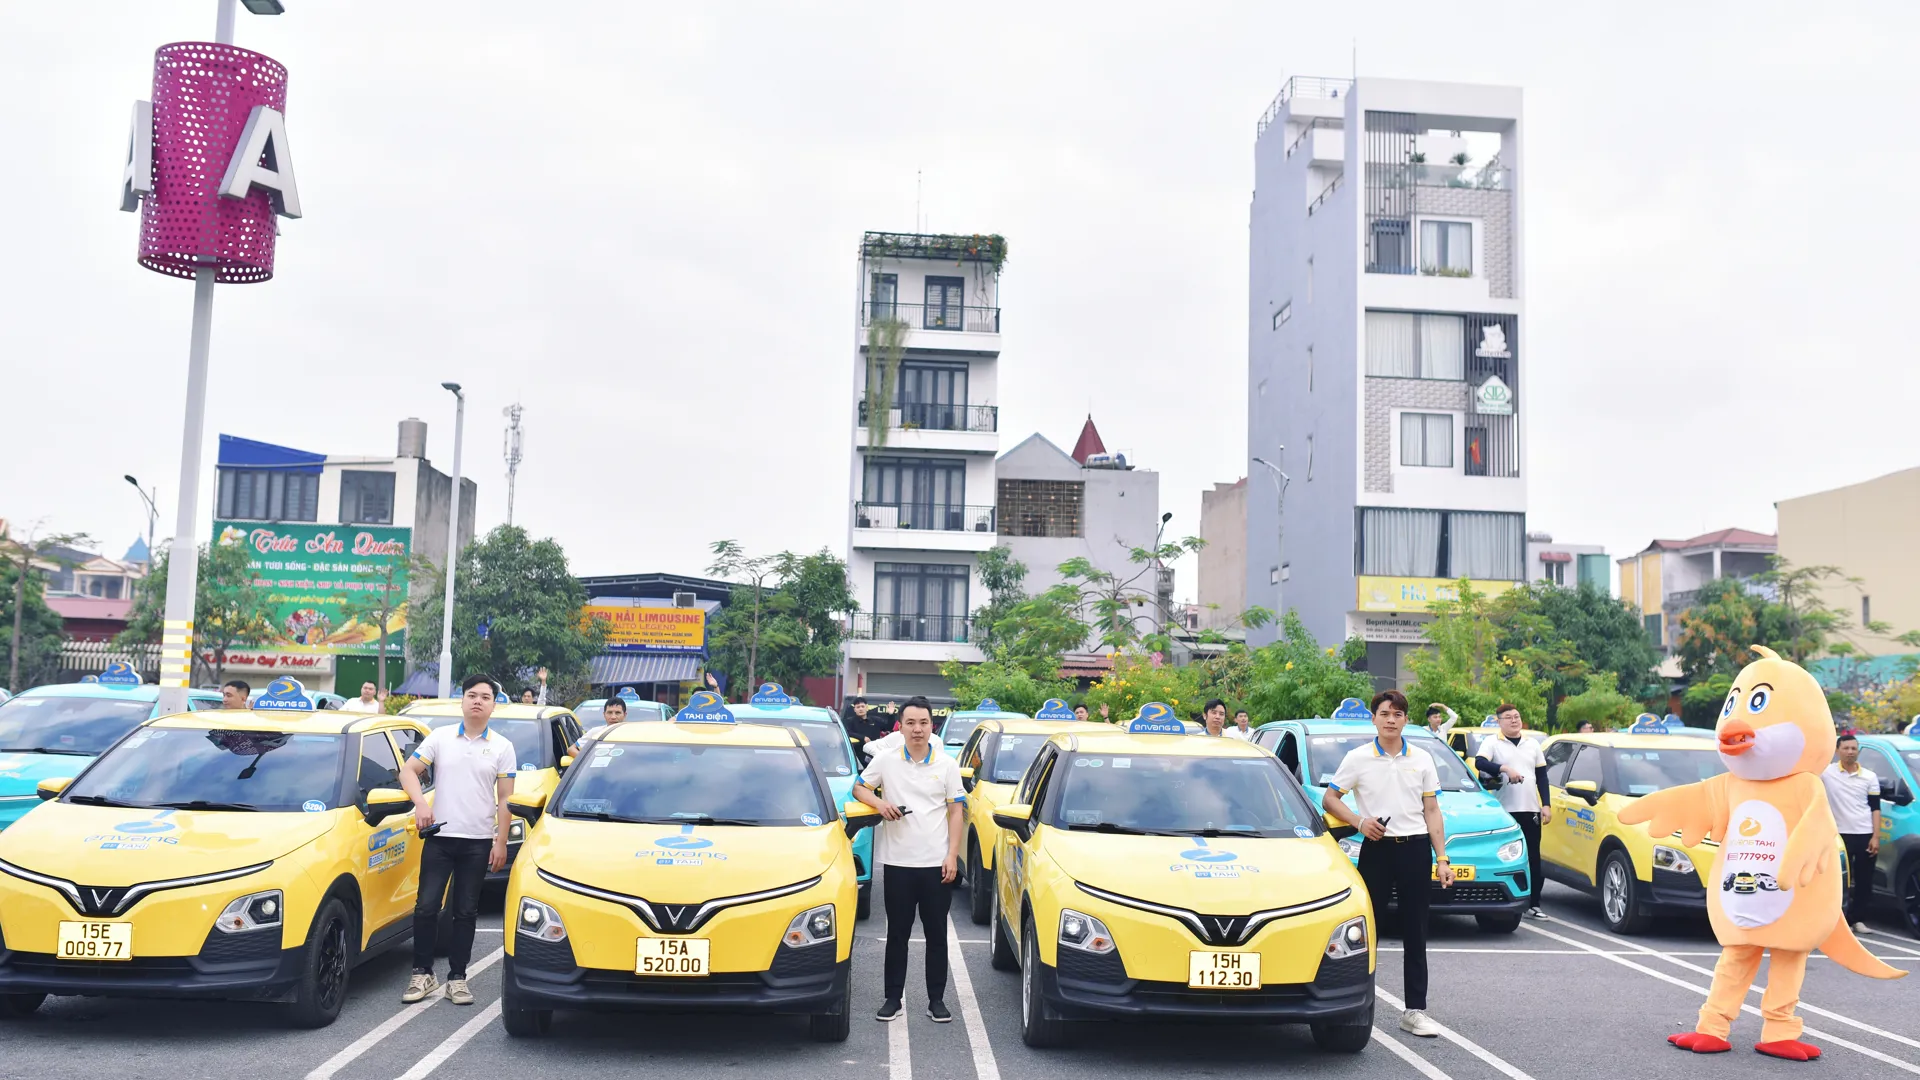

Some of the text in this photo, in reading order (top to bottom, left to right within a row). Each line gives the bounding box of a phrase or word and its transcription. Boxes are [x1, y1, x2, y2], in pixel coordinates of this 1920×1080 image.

[217, 105, 302, 219] A
[250, 528, 298, 554] Trúc
[305, 531, 344, 554] An
[616, 609, 635, 622] HẢI
[639, 613, 700, 624] LIMOUSINE
[640, 623, 676, 631] LEGEND
[1755, 839, 1776, 848] TAXI
[1739, 852, 1776, 862] 777999
[81, 923, 111, 939] 15E
[65, 940, 123, 957] 009.77
[659, 939, 688, 955] 15A
[643, 956, 701, 973] 520.00
[1212, 953, 1241, 969] 15H
[1198, 970, 1253, 986] 112.30
